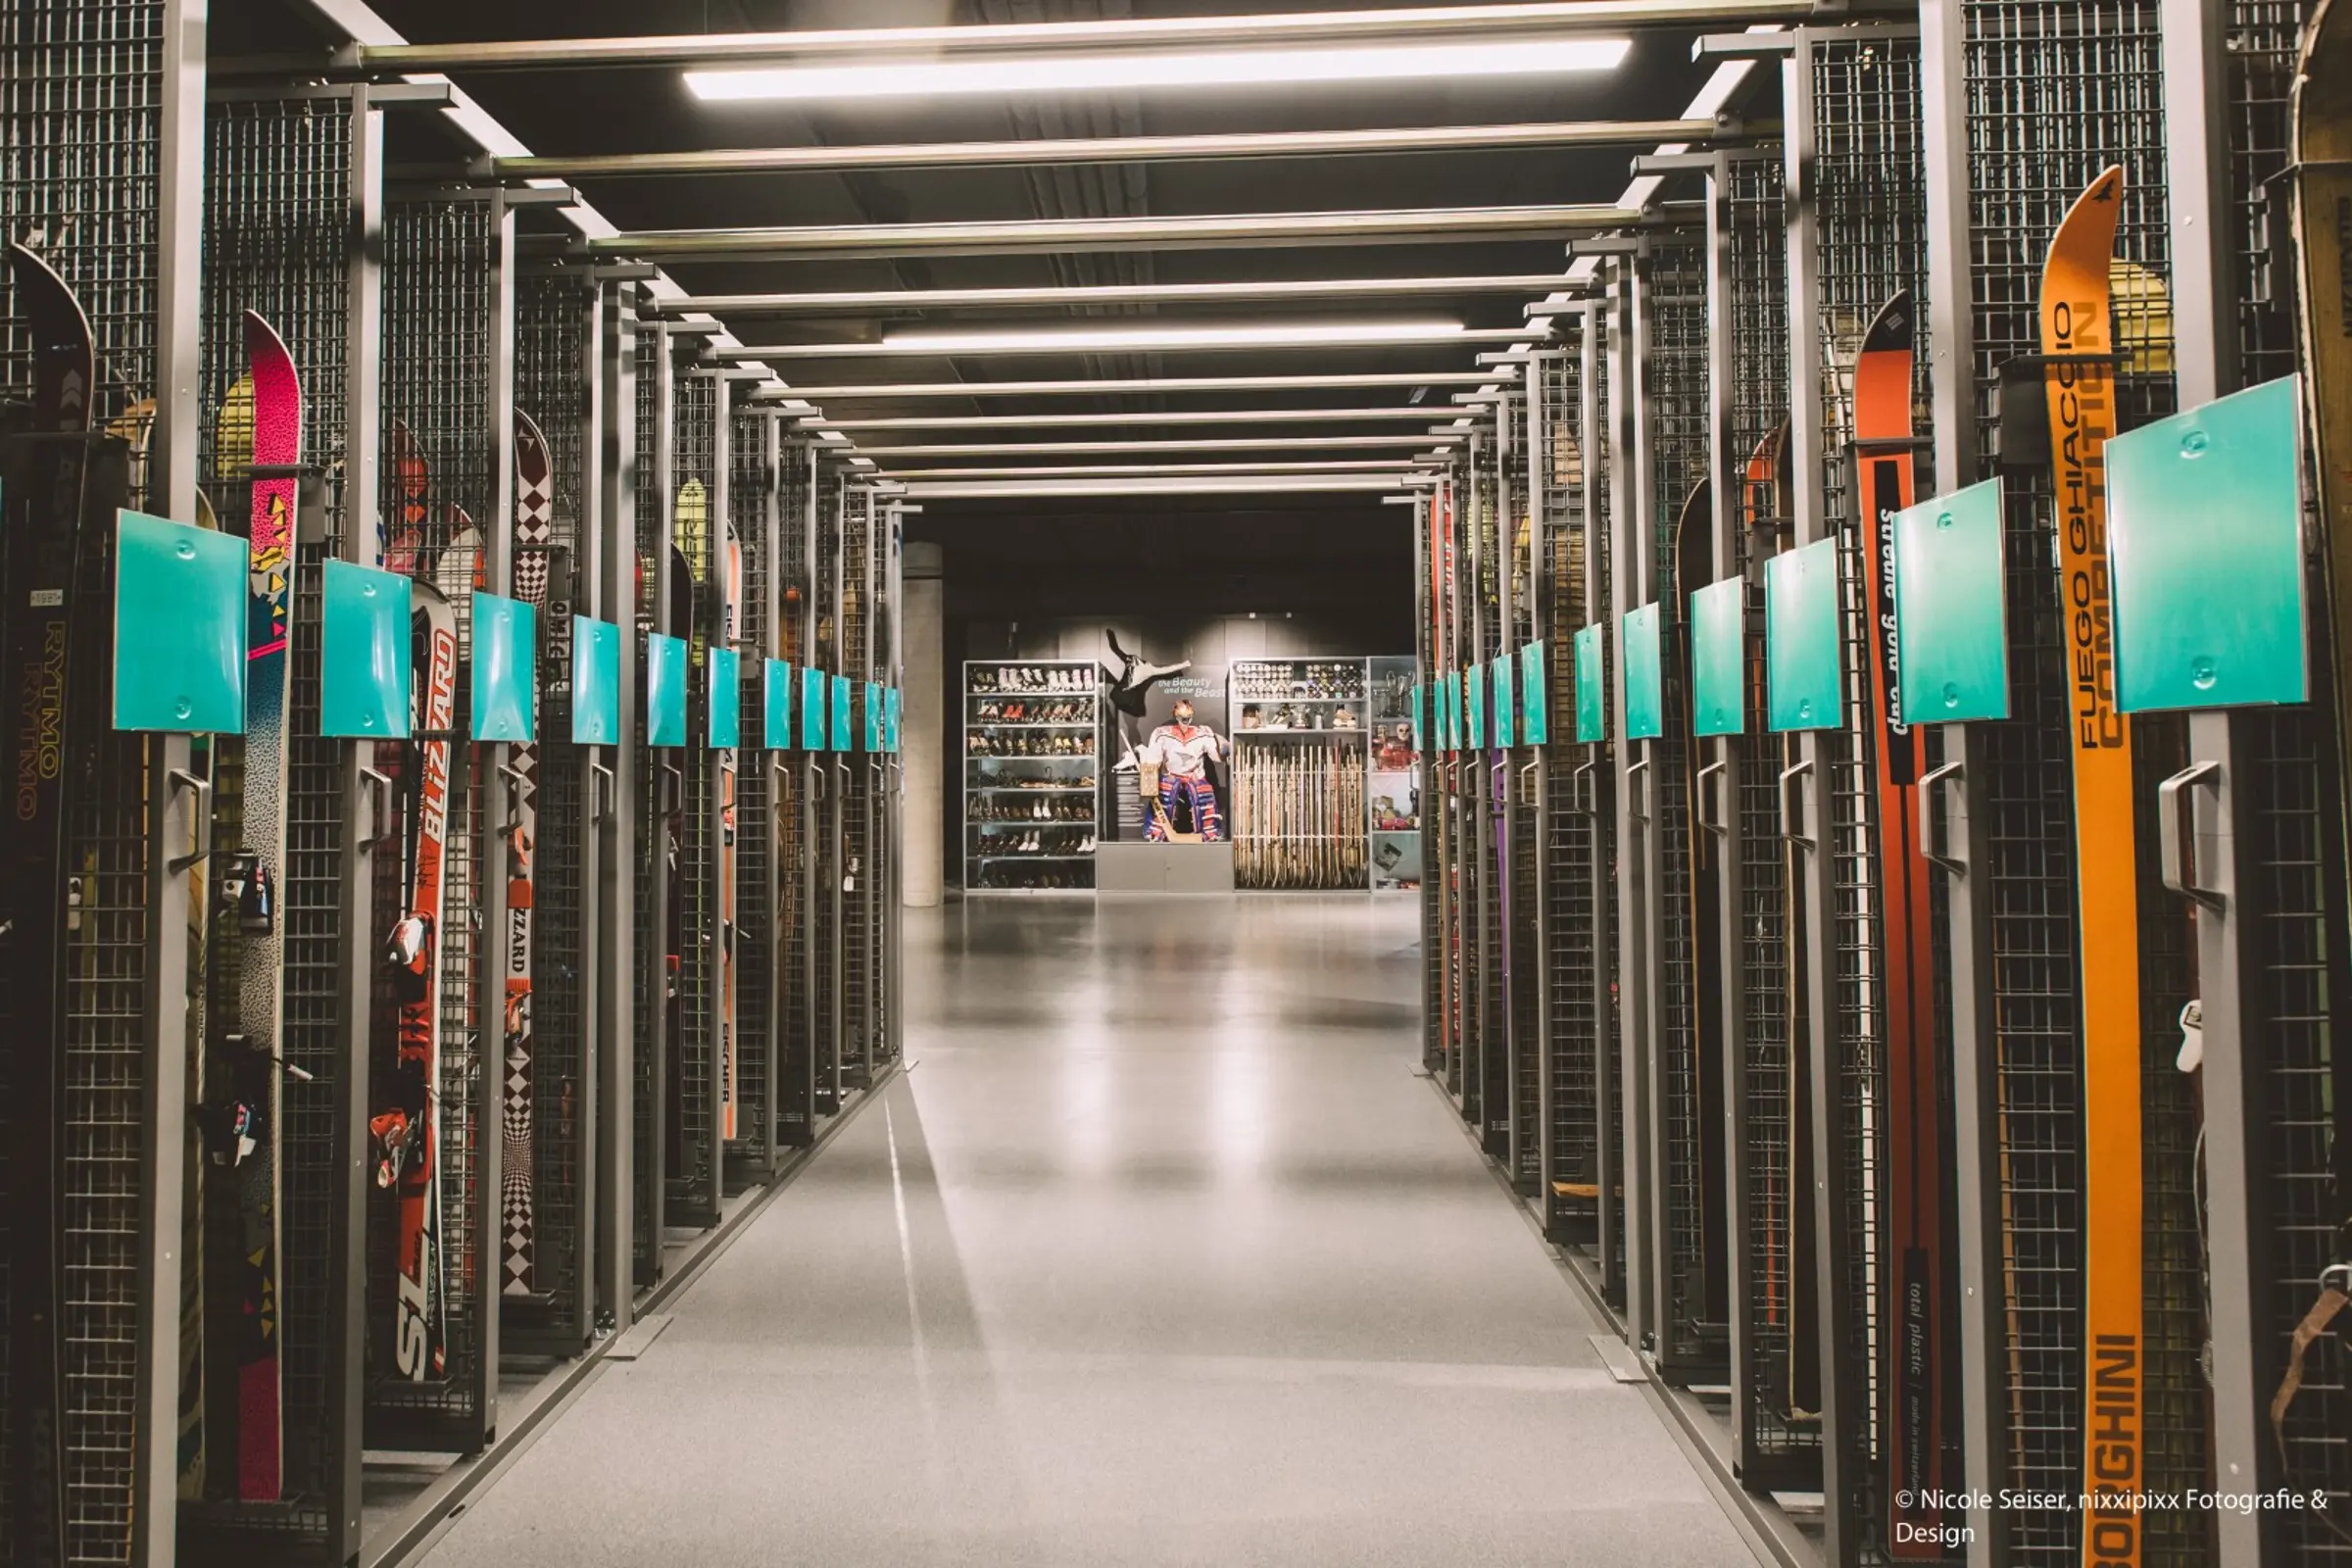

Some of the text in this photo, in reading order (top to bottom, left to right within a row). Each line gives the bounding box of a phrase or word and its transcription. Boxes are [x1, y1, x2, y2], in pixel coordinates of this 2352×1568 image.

[2054, 302, 2097, 749] FUEGO GHIACCIO
[39, 621, 66, 778] RYTMO
[1172, 676, 1211, 688] Beauty
[1195, 688, 1226, 698] Beast
[18, 662, 42, 820] RYTMO
[1908, 1323, 1925, 1376] plastic
[1910, 1282, 1925, 1318] total
[2093, 1335, 2136, 1568] ORGHINI
